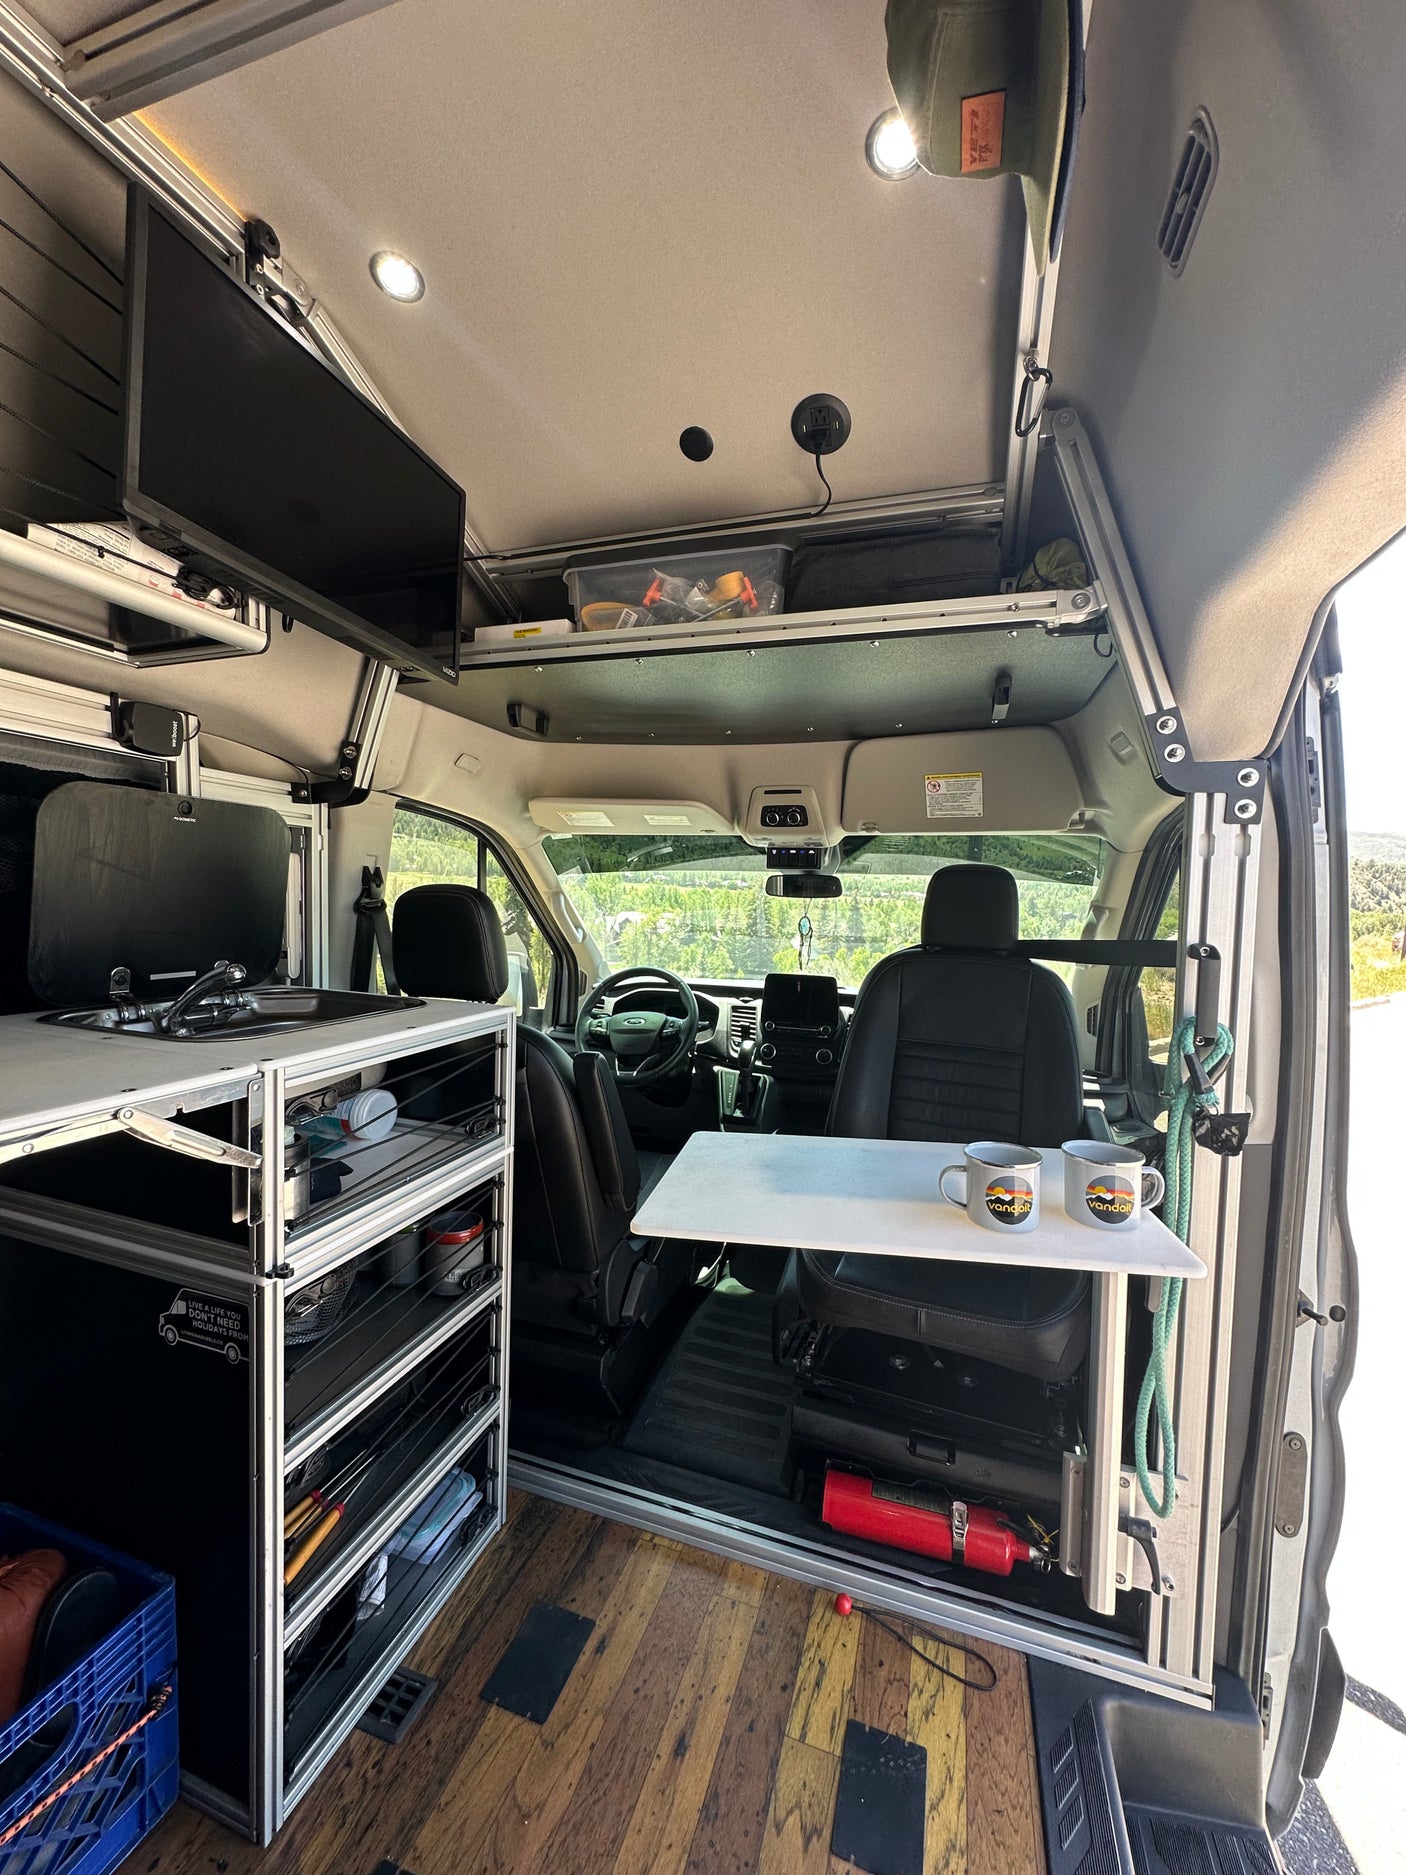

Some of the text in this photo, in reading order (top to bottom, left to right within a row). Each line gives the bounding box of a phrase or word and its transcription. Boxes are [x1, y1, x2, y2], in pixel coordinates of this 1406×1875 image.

[988, 1201, 1032, 1214] vandoit
[1088, 1199, 1133, 1213] vandoit
[188, 1300, 203, 1311] LIVE
[210, 1306, 225, 1316] LIFE
[226, 1310, 241, 1321] YOU
[188, 1308, 241, 1330] DON'T NEED
[192, 1319, 249, 1342] HOLIDAYS FROM
